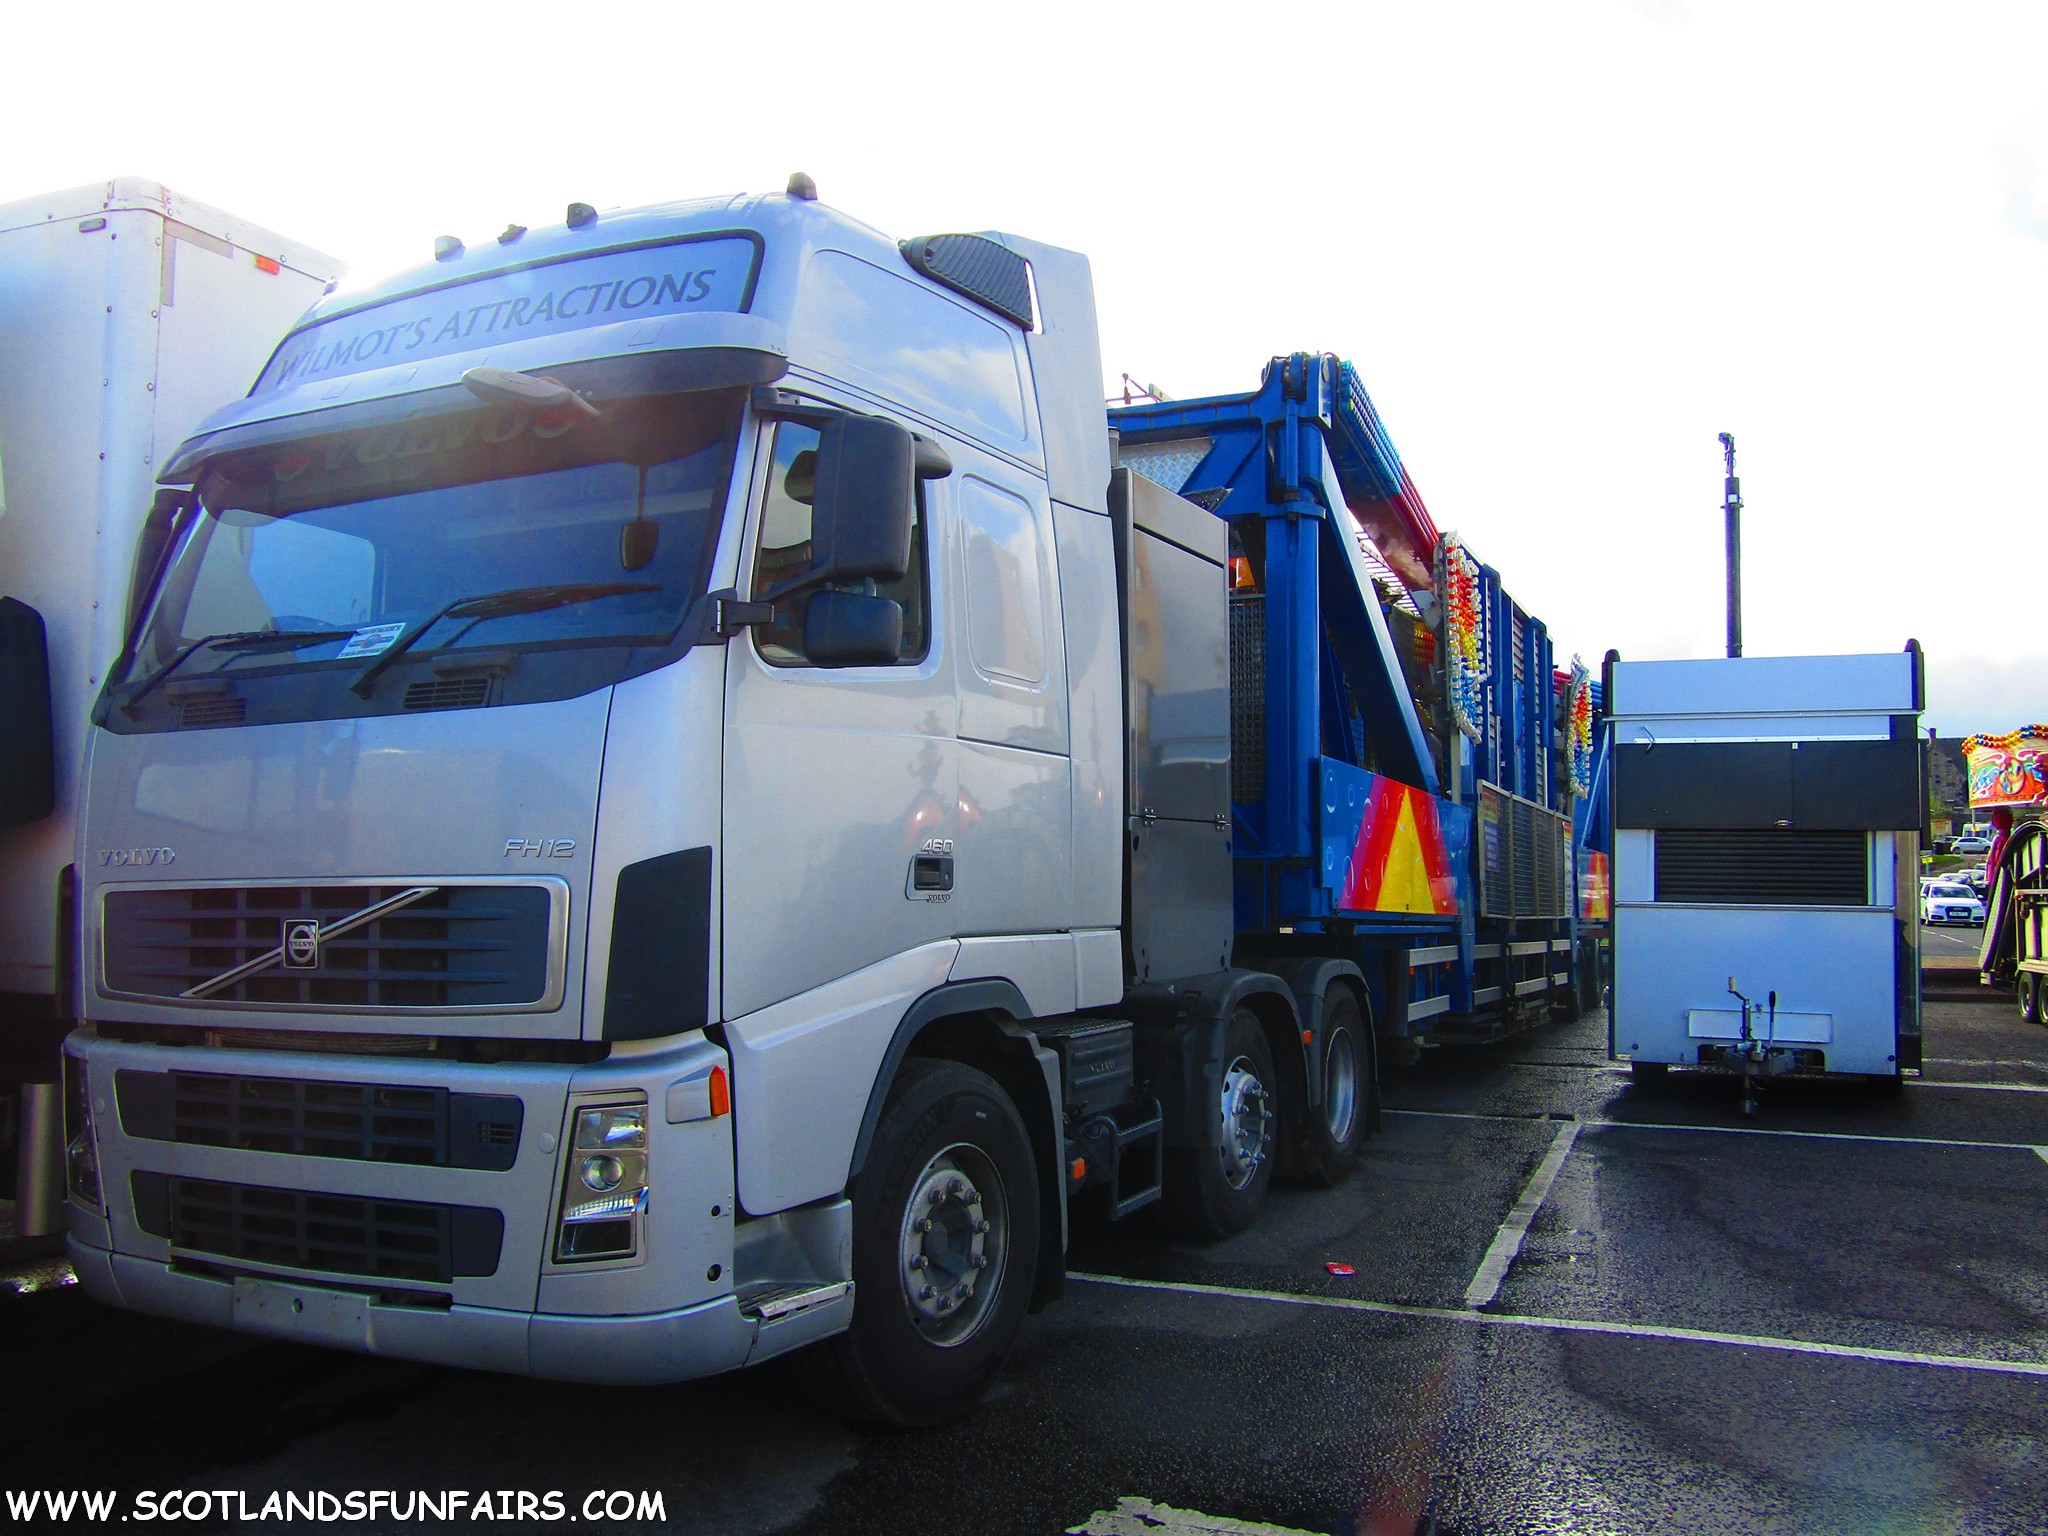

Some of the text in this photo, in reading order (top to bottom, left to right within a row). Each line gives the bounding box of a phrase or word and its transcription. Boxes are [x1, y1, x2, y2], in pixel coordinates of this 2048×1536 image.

[275, 268, 716, 386] WILMOT'S ATTRACTIONS
[920, 838, 954, 854] 460
[96, 846, 175, 866] VOLVO
[928, 894, 951, 903] VOLVO
